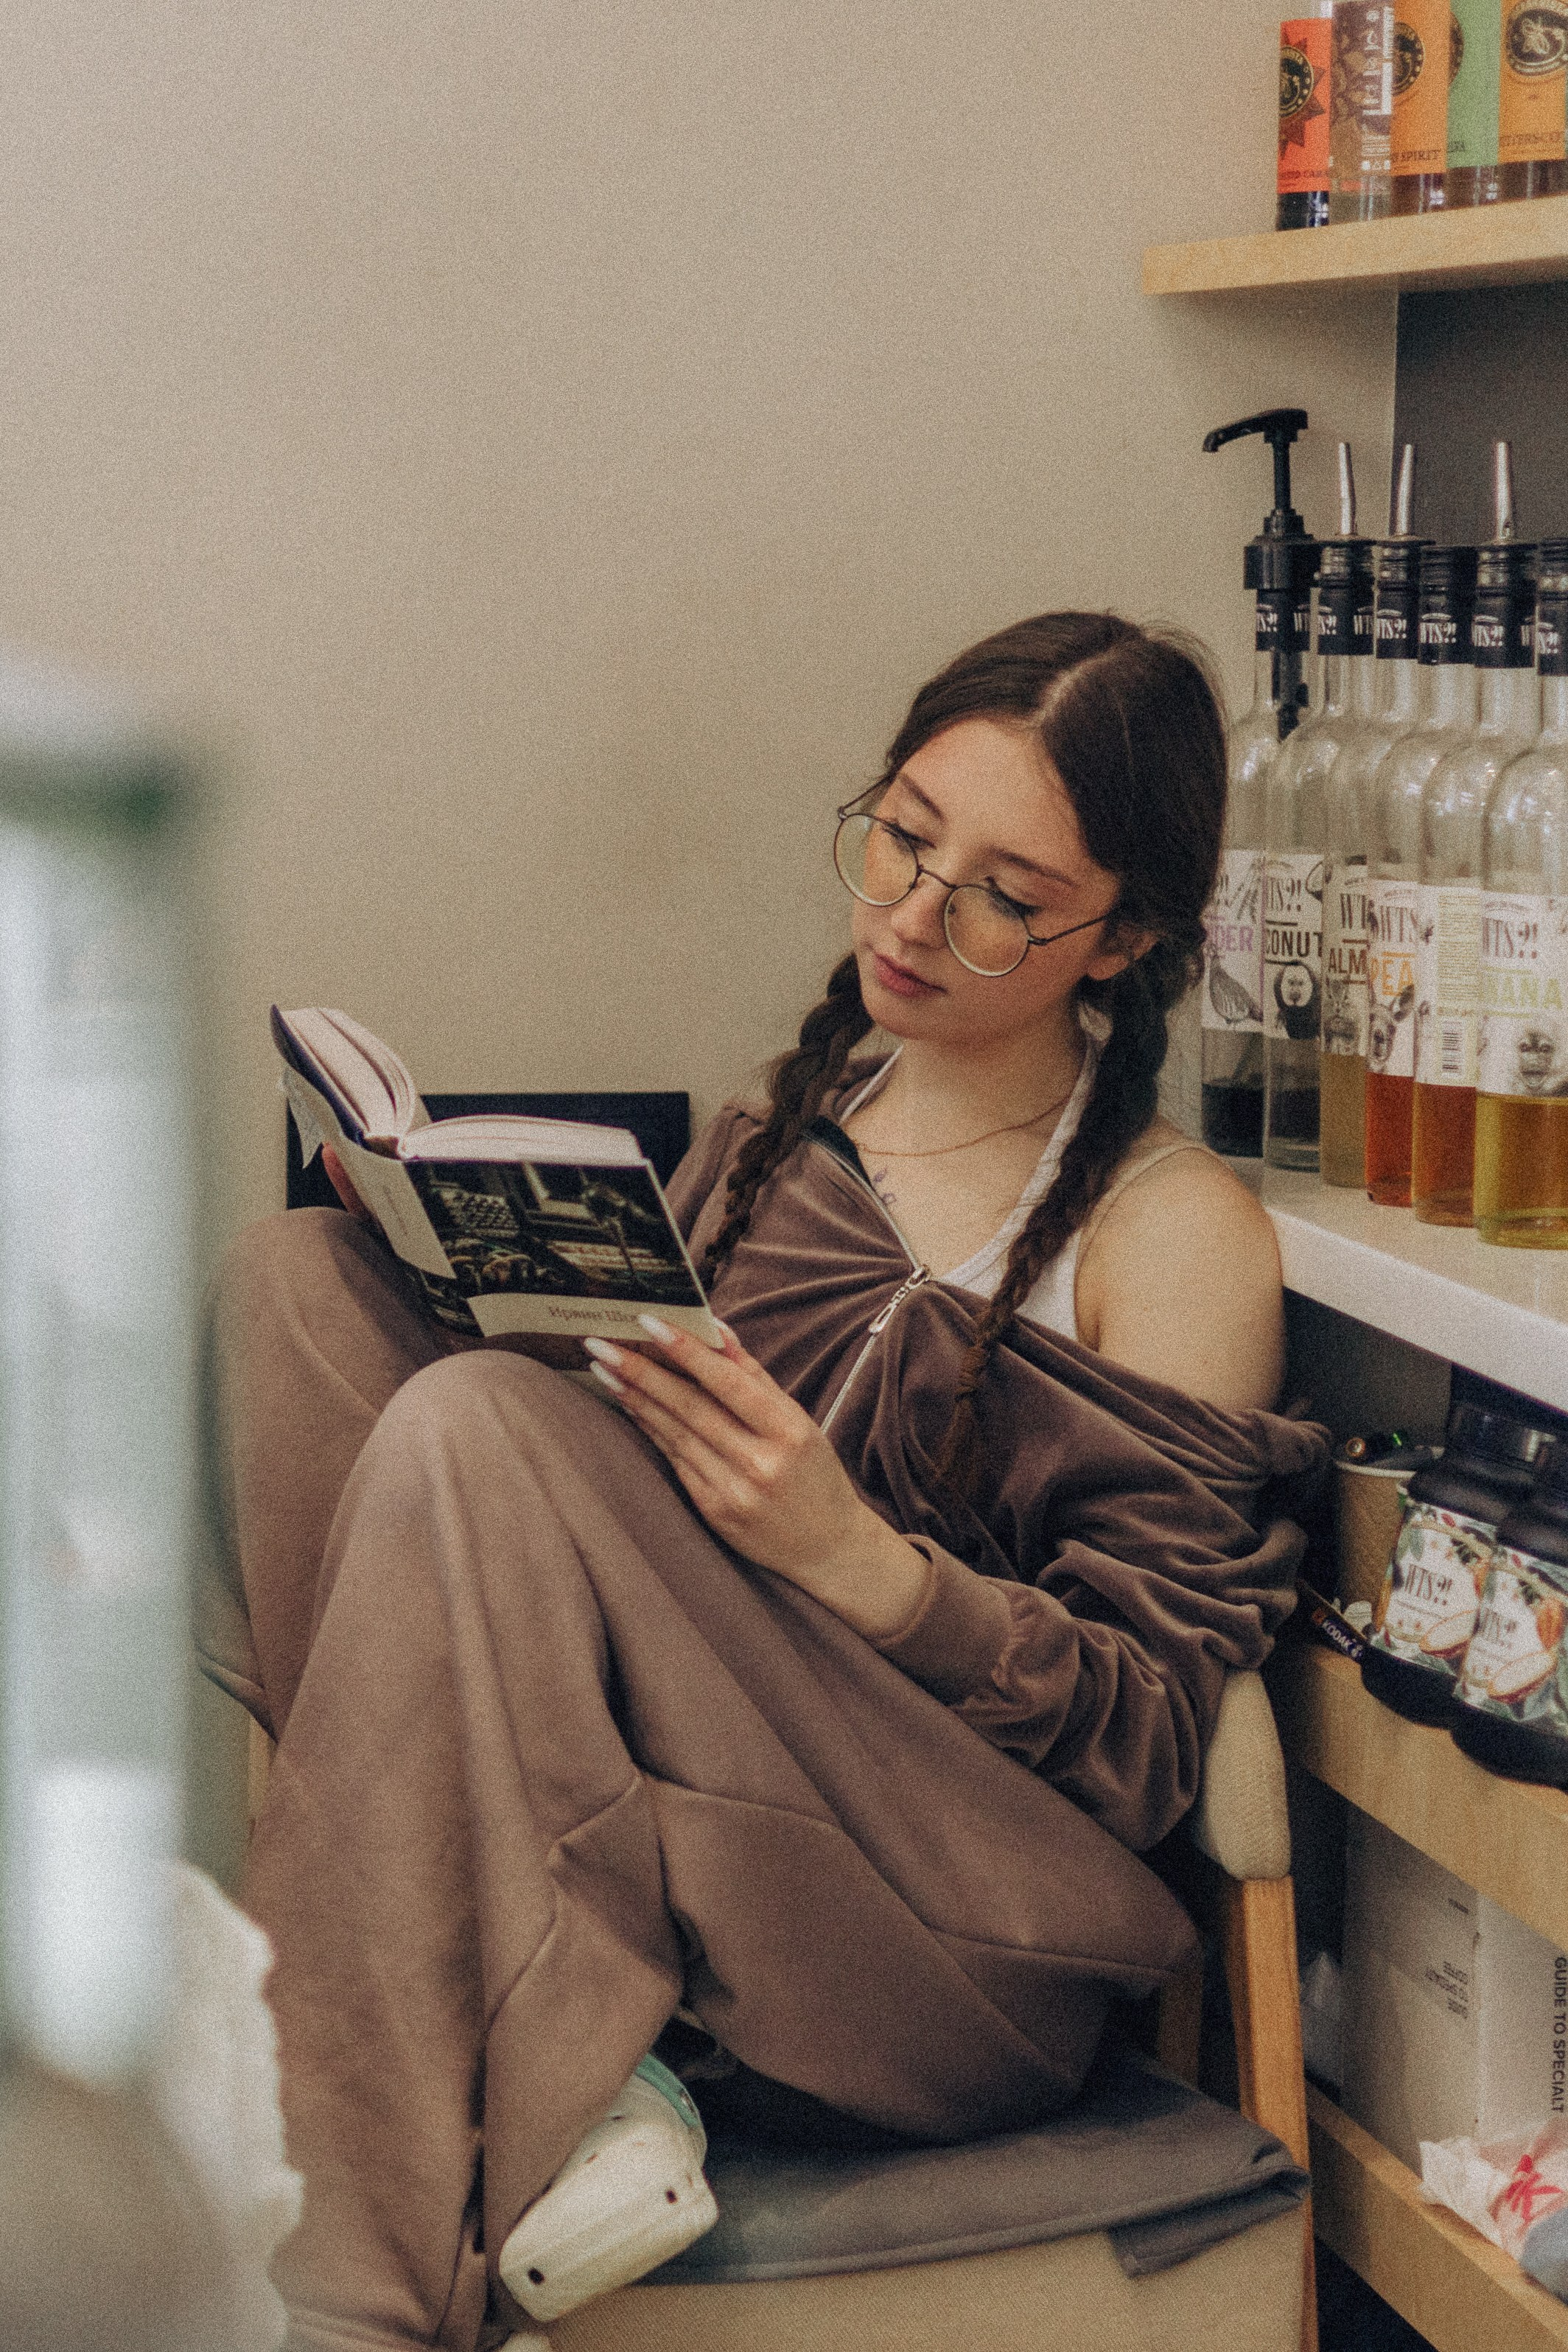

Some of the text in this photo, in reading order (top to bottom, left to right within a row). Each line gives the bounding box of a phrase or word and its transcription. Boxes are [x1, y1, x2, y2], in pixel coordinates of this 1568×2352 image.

[1329, 948, 1368, 975] ALM
[1371, 957, 1414, 996] PEA
[1554, 1956, 1567, 2008] GUIDE
[1553, 2012, 1567, 2035] TO
